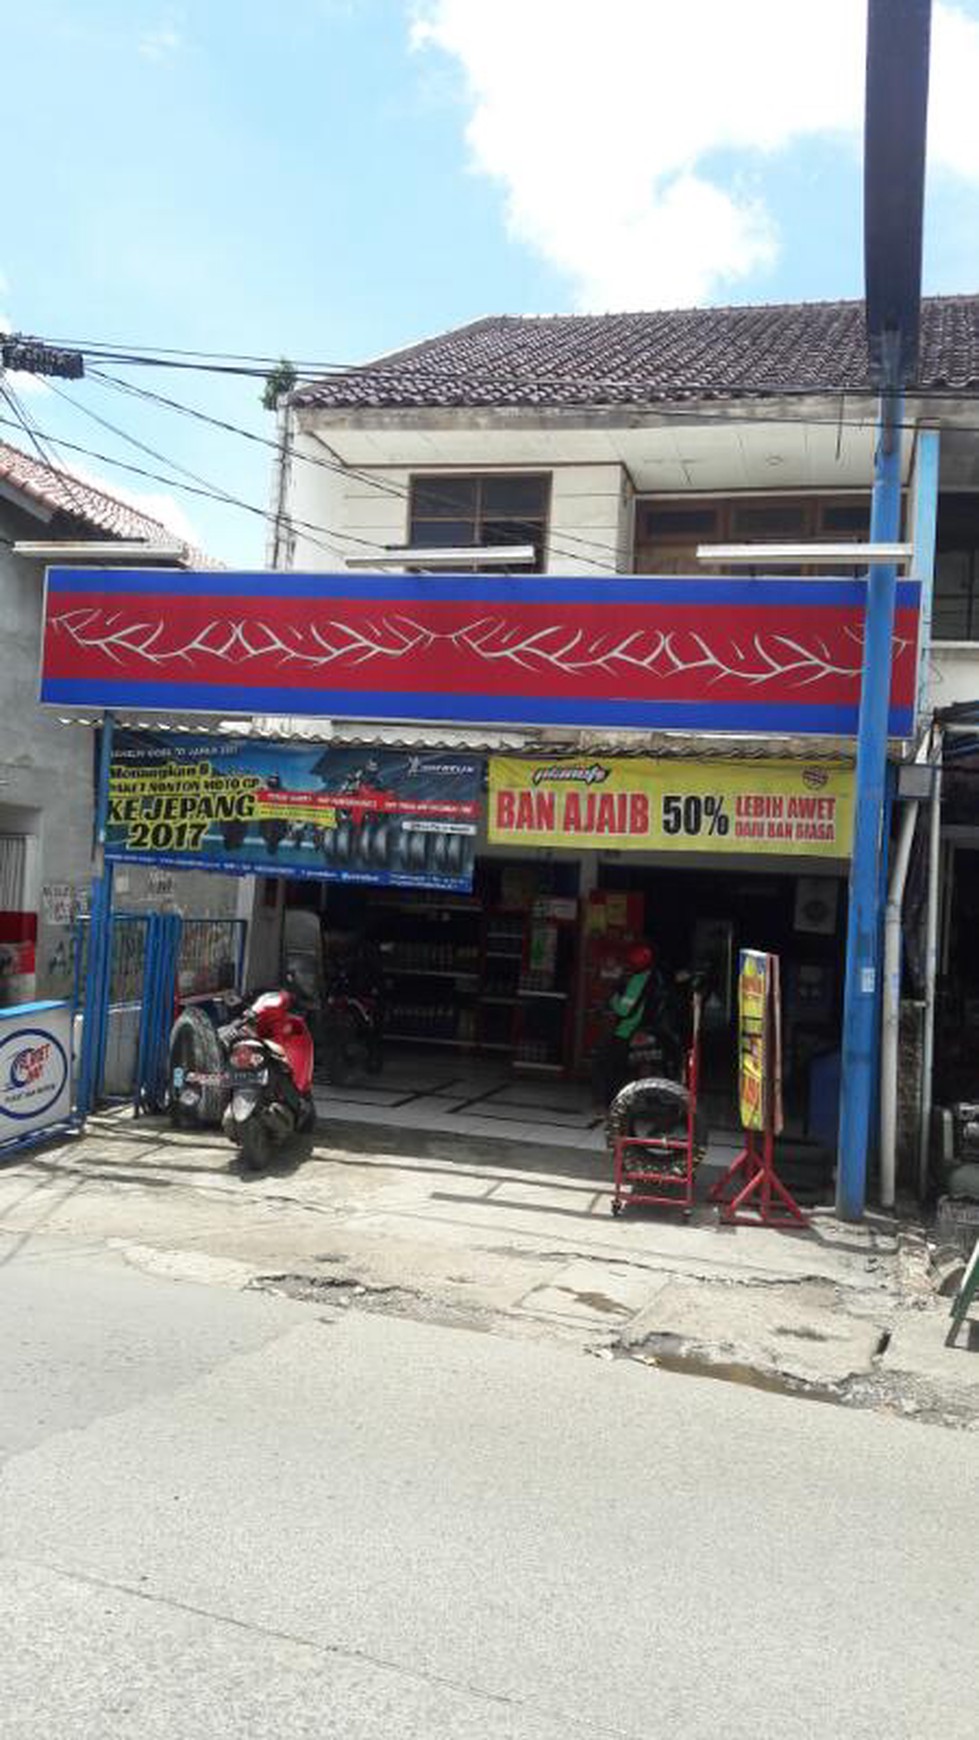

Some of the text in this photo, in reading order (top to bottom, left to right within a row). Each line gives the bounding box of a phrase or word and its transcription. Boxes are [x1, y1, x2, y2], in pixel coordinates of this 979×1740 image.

[110, 798, 140, 821] KE
[143, 793, 256, 820] JEPANG
[496, 789, 729, 836] BAN AJAIB 50%
[735, 796, 836, 820] LEBIH AWET
[129, 822, 208, 848] 2017
